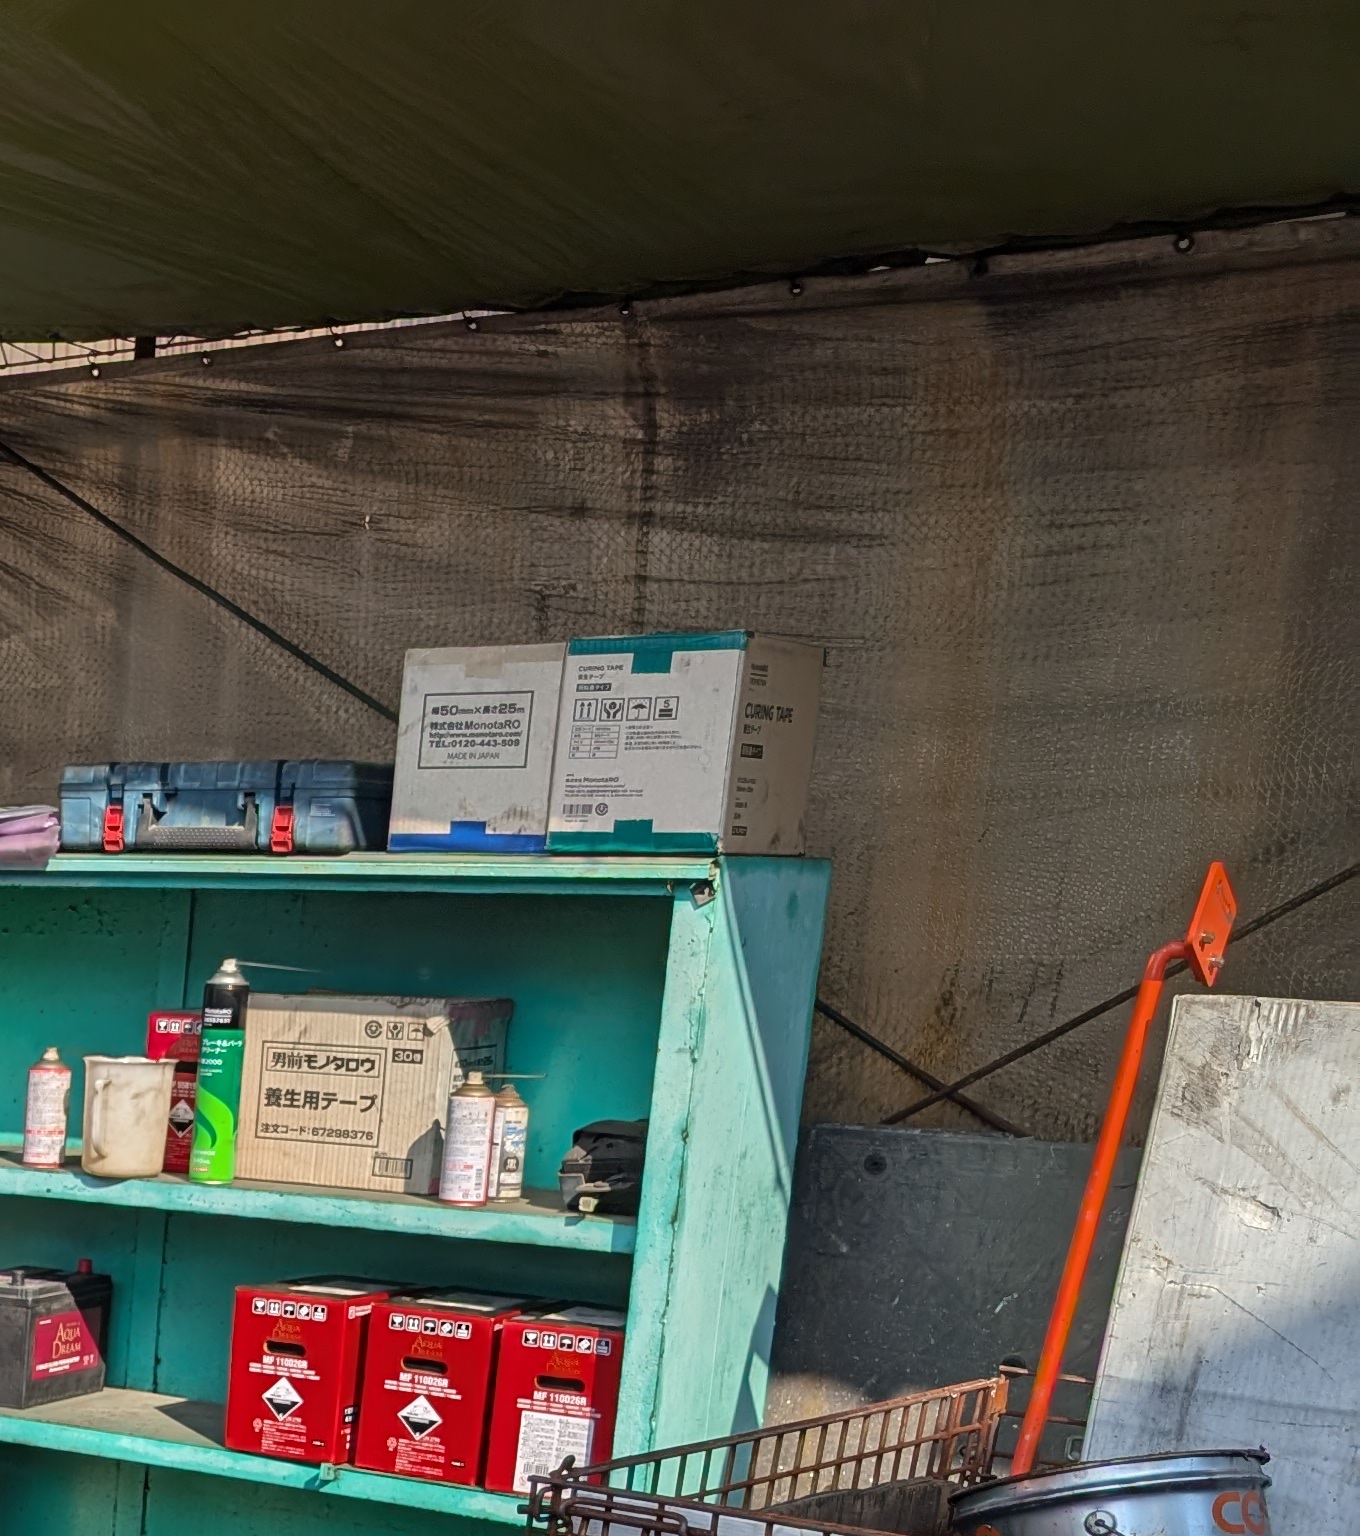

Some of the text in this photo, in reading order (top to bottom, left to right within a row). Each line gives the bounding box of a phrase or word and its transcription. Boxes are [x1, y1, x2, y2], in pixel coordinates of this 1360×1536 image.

[447, 752, 500, 760] MADE IN JAPAN
[271, 1051, 376, 1073] 男前モノタロウ
[264, 1087, 378, 1113] 養生用テープ
[55, 1322, 81, 1342] AQUA
[52, 1341, 82, 1359] DREAM
[399, 1372, 413, 1383] MF
[533, 1390, 547, 1401] MF
